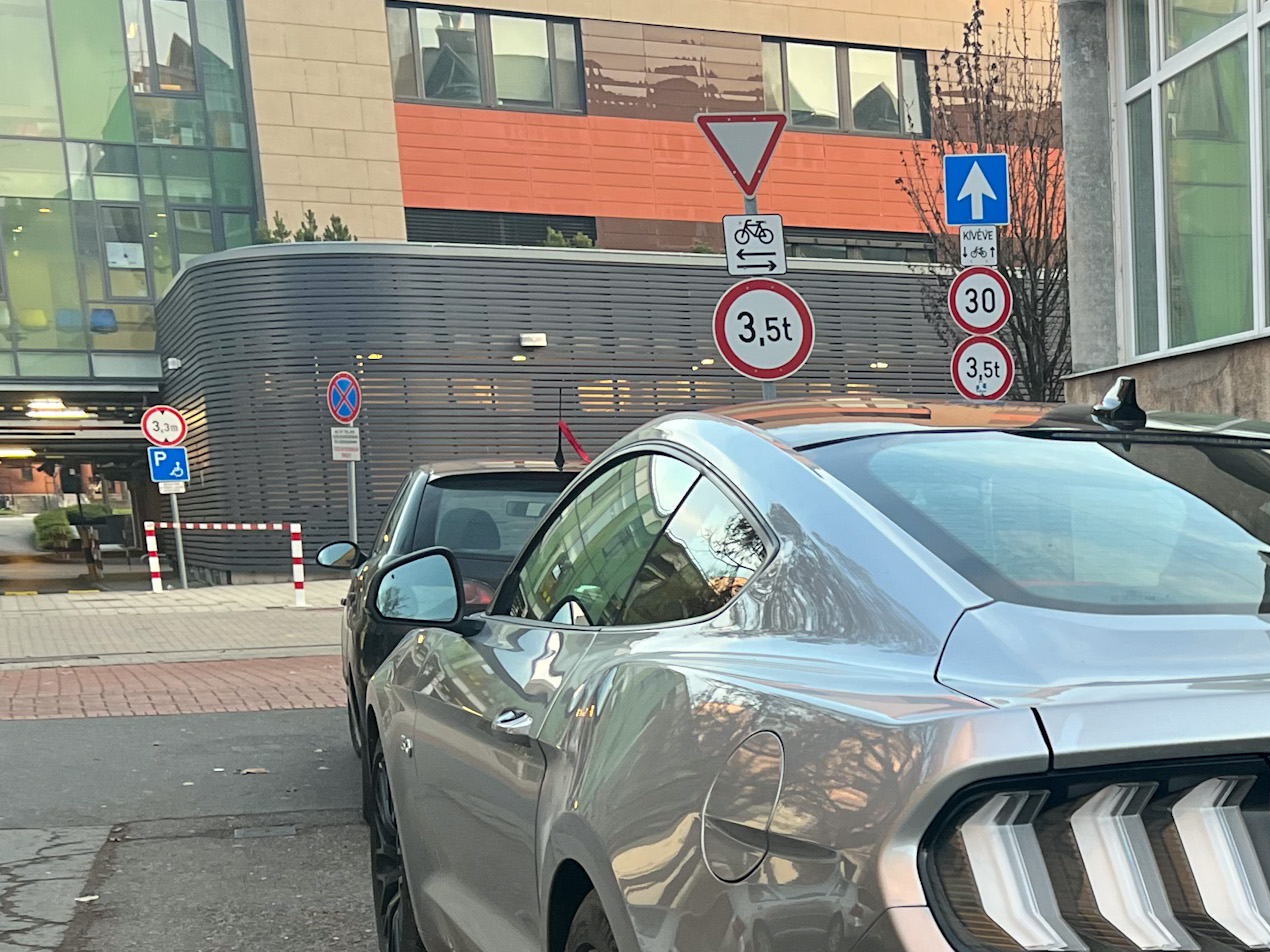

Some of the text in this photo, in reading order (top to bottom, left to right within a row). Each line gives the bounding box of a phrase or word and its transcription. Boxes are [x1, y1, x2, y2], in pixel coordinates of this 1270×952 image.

[963, 229, 994, 241] KIVÉVE
[965, 287, 996, 314] 30
[737, 311, 793, 347] 3,5t
[966, 357, 1000, 381] 3,5t
[152, 421, 178, 433] 3,3m
[154, 451, 167, 467] P
